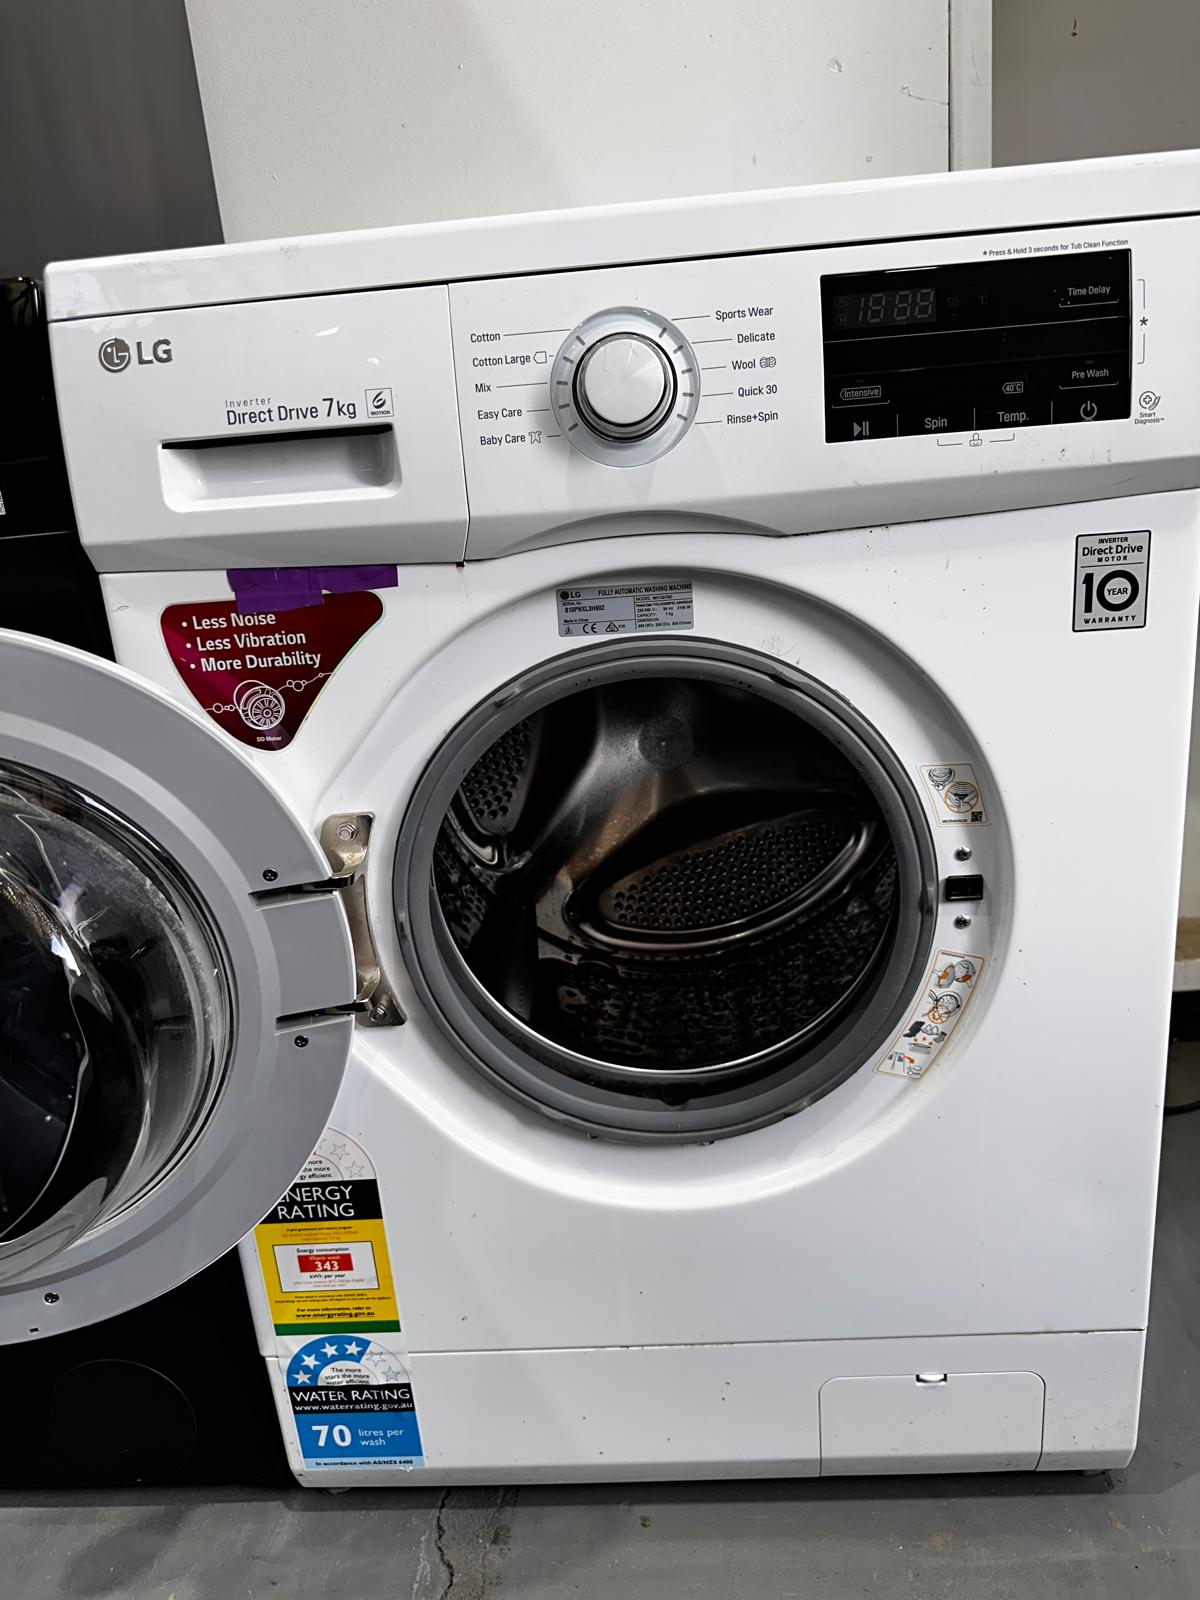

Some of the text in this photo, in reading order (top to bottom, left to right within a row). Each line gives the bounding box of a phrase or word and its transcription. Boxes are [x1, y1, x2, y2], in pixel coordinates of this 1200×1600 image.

[988, 249, 1007, 257] Press
[1013, 246, 1027, 254] Hold
[1033, 244, 1059, 253] seconds
[1060, 243, 1069, 251] for
[1070, 242, 1083, 250] Tub
[1083, 240, 1101, 249] Clean
[1101, 239, 1129, 247] Function
[1067, 285, 1111, 296] Time Delay
[715, 306, 774, 322] Sports Wear
[470, 332, 501, 343] Cotton
[737, 332, 776, 344] Delicate
[136, 338, 173, 365] LG
[472, 354, 531, 367] Cotton Large
[731, 359, 756, 370] Wool
[1071, 369, 1109, 380] Pre Wash
[475, 382, 492, 393] Mix
[737, 384, 778, 397] Quick 30
[844, 386, 879, 399] Intensive
[225, 396, 271, 408] Inverter
[226, 397, 357, 425] Direct Drive 7kg
[477, 408, 523, 420] Easy Care
[997, 411, 1029, 423] Temp.
[727, 411, 779, 425] Rinse+Spin
[924, 417, 948, 430] Spin
[480, 434, 526, 446] Baby Care
[1098, 536, 1129, 544] INVERTER
[1082, 543, 1144, 557] Direct Drive
[598, 588, 614, 596] FULLY
[614, 586, 643, 595] AUTOMATIC
[1082, 569, 1140, 613] 10
[1106, 587, 1128, 595] YEAR
[192, 612, 276, 629] Less Noise
[1083, 614, 1137, 624] WARRANTY
[196, 630, 306, 651] Less Vibration
[200, 650, 321, 672] More Durability
[277, 1202, 355, 1220] RATING
[314, 1260, 339, 1271] 343
[295, 1310, 375, 1319] www.energyrating.gov.au
[292, 1388, 410, 1402] WATER RATING
[294, 1402, 413, 1411] www.waterrating.gov.au
[311, 1424, 352, 1447] 70
[358, 1428, 404, 1438] litres per
[360, 1437, 386, 1446] wash
